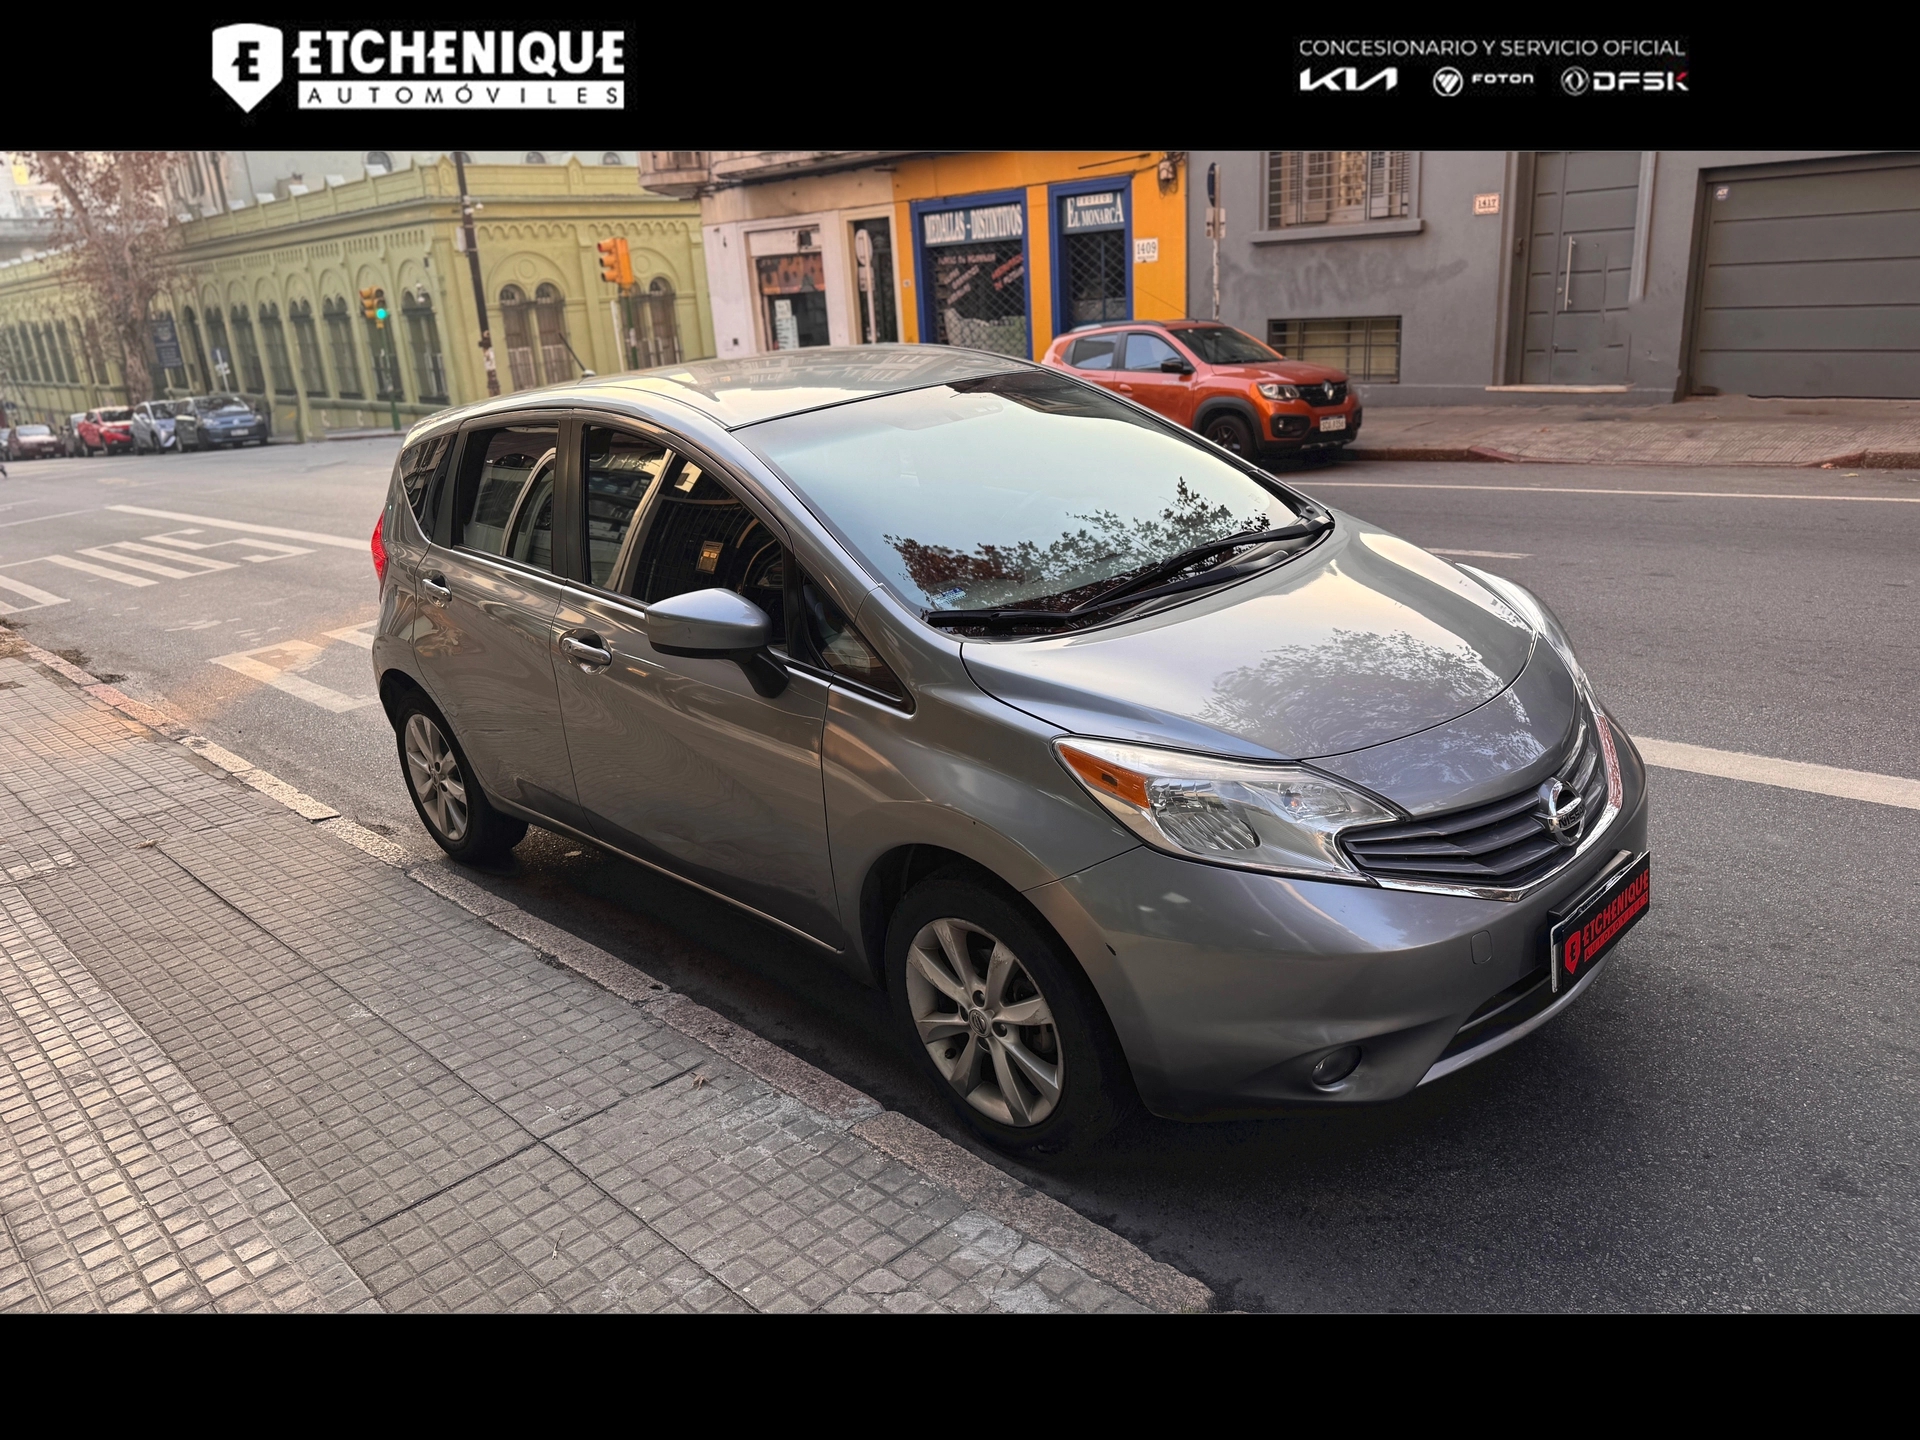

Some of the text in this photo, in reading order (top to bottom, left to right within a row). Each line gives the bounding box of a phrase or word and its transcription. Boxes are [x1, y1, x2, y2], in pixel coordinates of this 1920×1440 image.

[1478, 198, 1497, 207] 1417
[924, 210, 965, 245] MEDALLAS
[970, 203, 1023, 240] DISTINTIVOS
[1136, 241, 1157, 255] 1409
[1582, 868, 1649, 947] ETCHENIQUE
